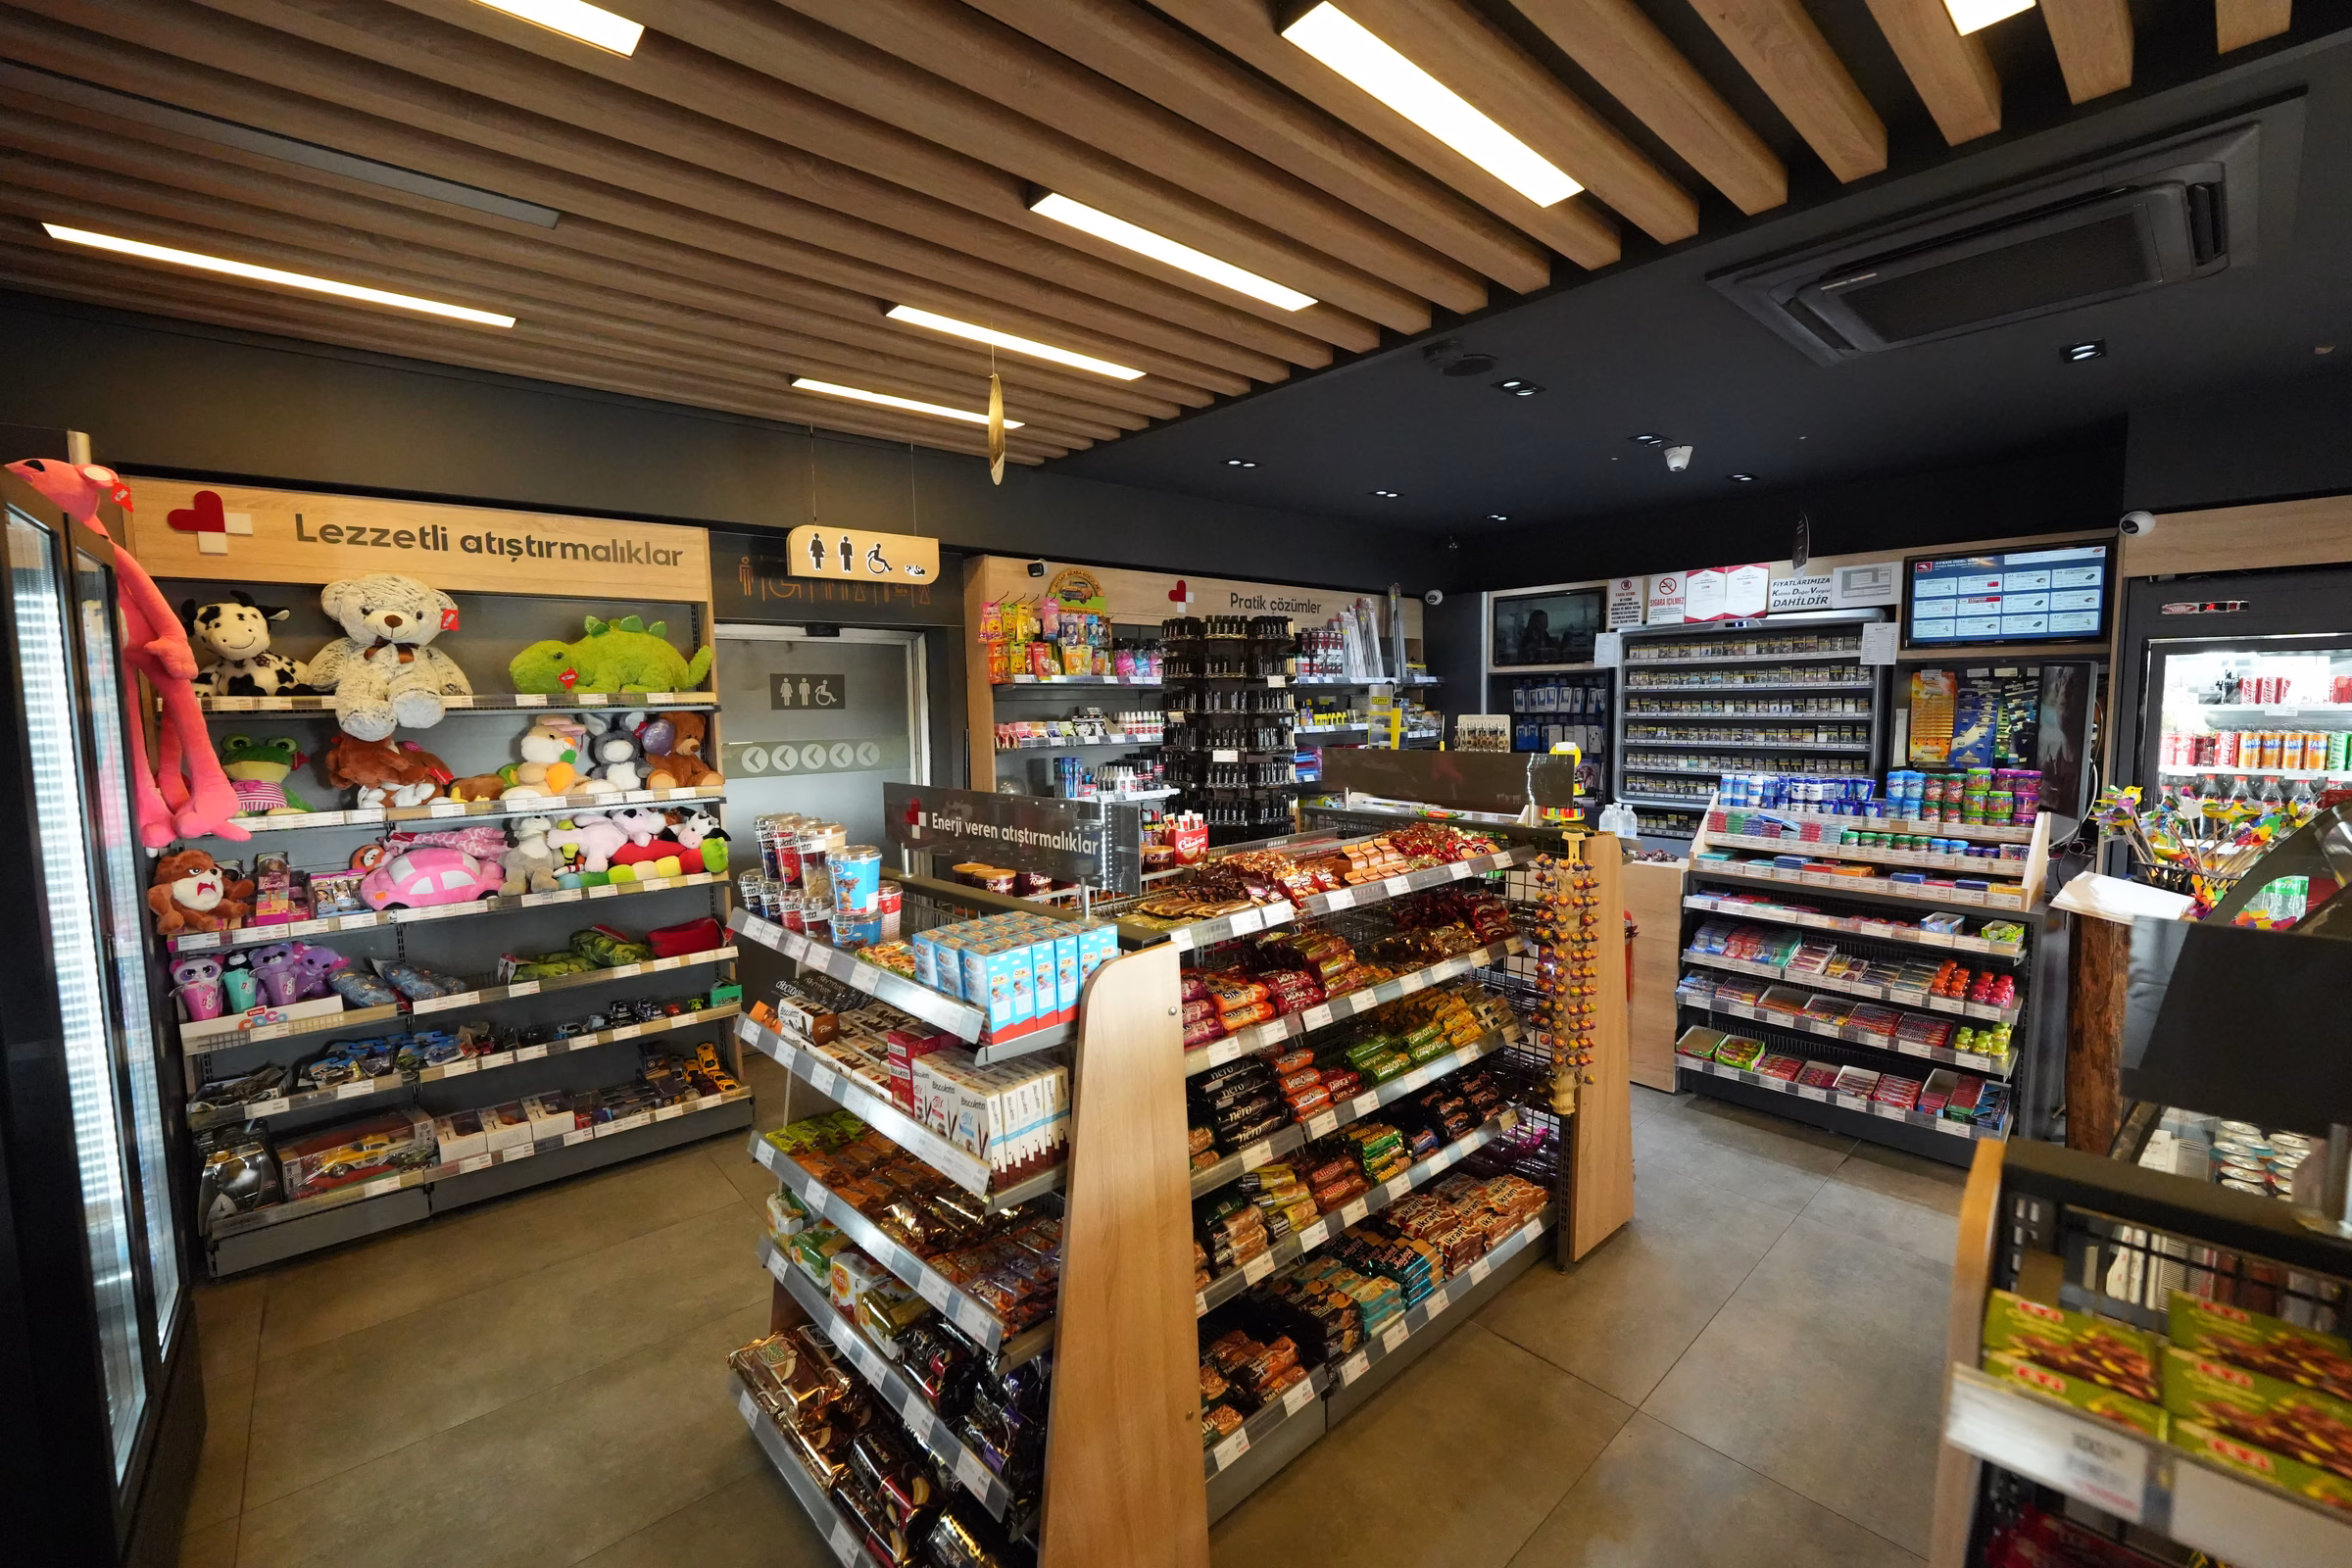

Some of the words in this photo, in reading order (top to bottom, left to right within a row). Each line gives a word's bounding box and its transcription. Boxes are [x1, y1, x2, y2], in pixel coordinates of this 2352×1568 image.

[295, 513, 449, 552] Lezzetli
[460, 530, 684, 566] atıştırmalıklar
[1230, 592, 1266, 611] Pratik
[1270, 597, 1322, 614] çözümler
[1649, 597, 1665, 607] SİGARA
[1666, 595, 1685, 607] İÇİLMEZ
[1772, 594, 1829, 608] DAHİLDİR
[932, 812, 962, 837] Enerji
[964, 822, 998, 840] veren
[1001, 825, 1100, 856] atıştırmalıklar
[1210, 1066, 1234, 1080] nero
[932, 1080, 956, 1095] Biscolata
[1221, 1083, 1246, 1098] nero
[960, 1097, 986, 1110] Biscolata
[1229, 1106, 1252, 1122] nero
[1238, 1126, 1263, 1143] nero
[1315, 1162, 1343, 1179] Albeni
[1323, 1180, 1350, 1198] Albeni
[1482, 1211, 1497, 1227] ikra
